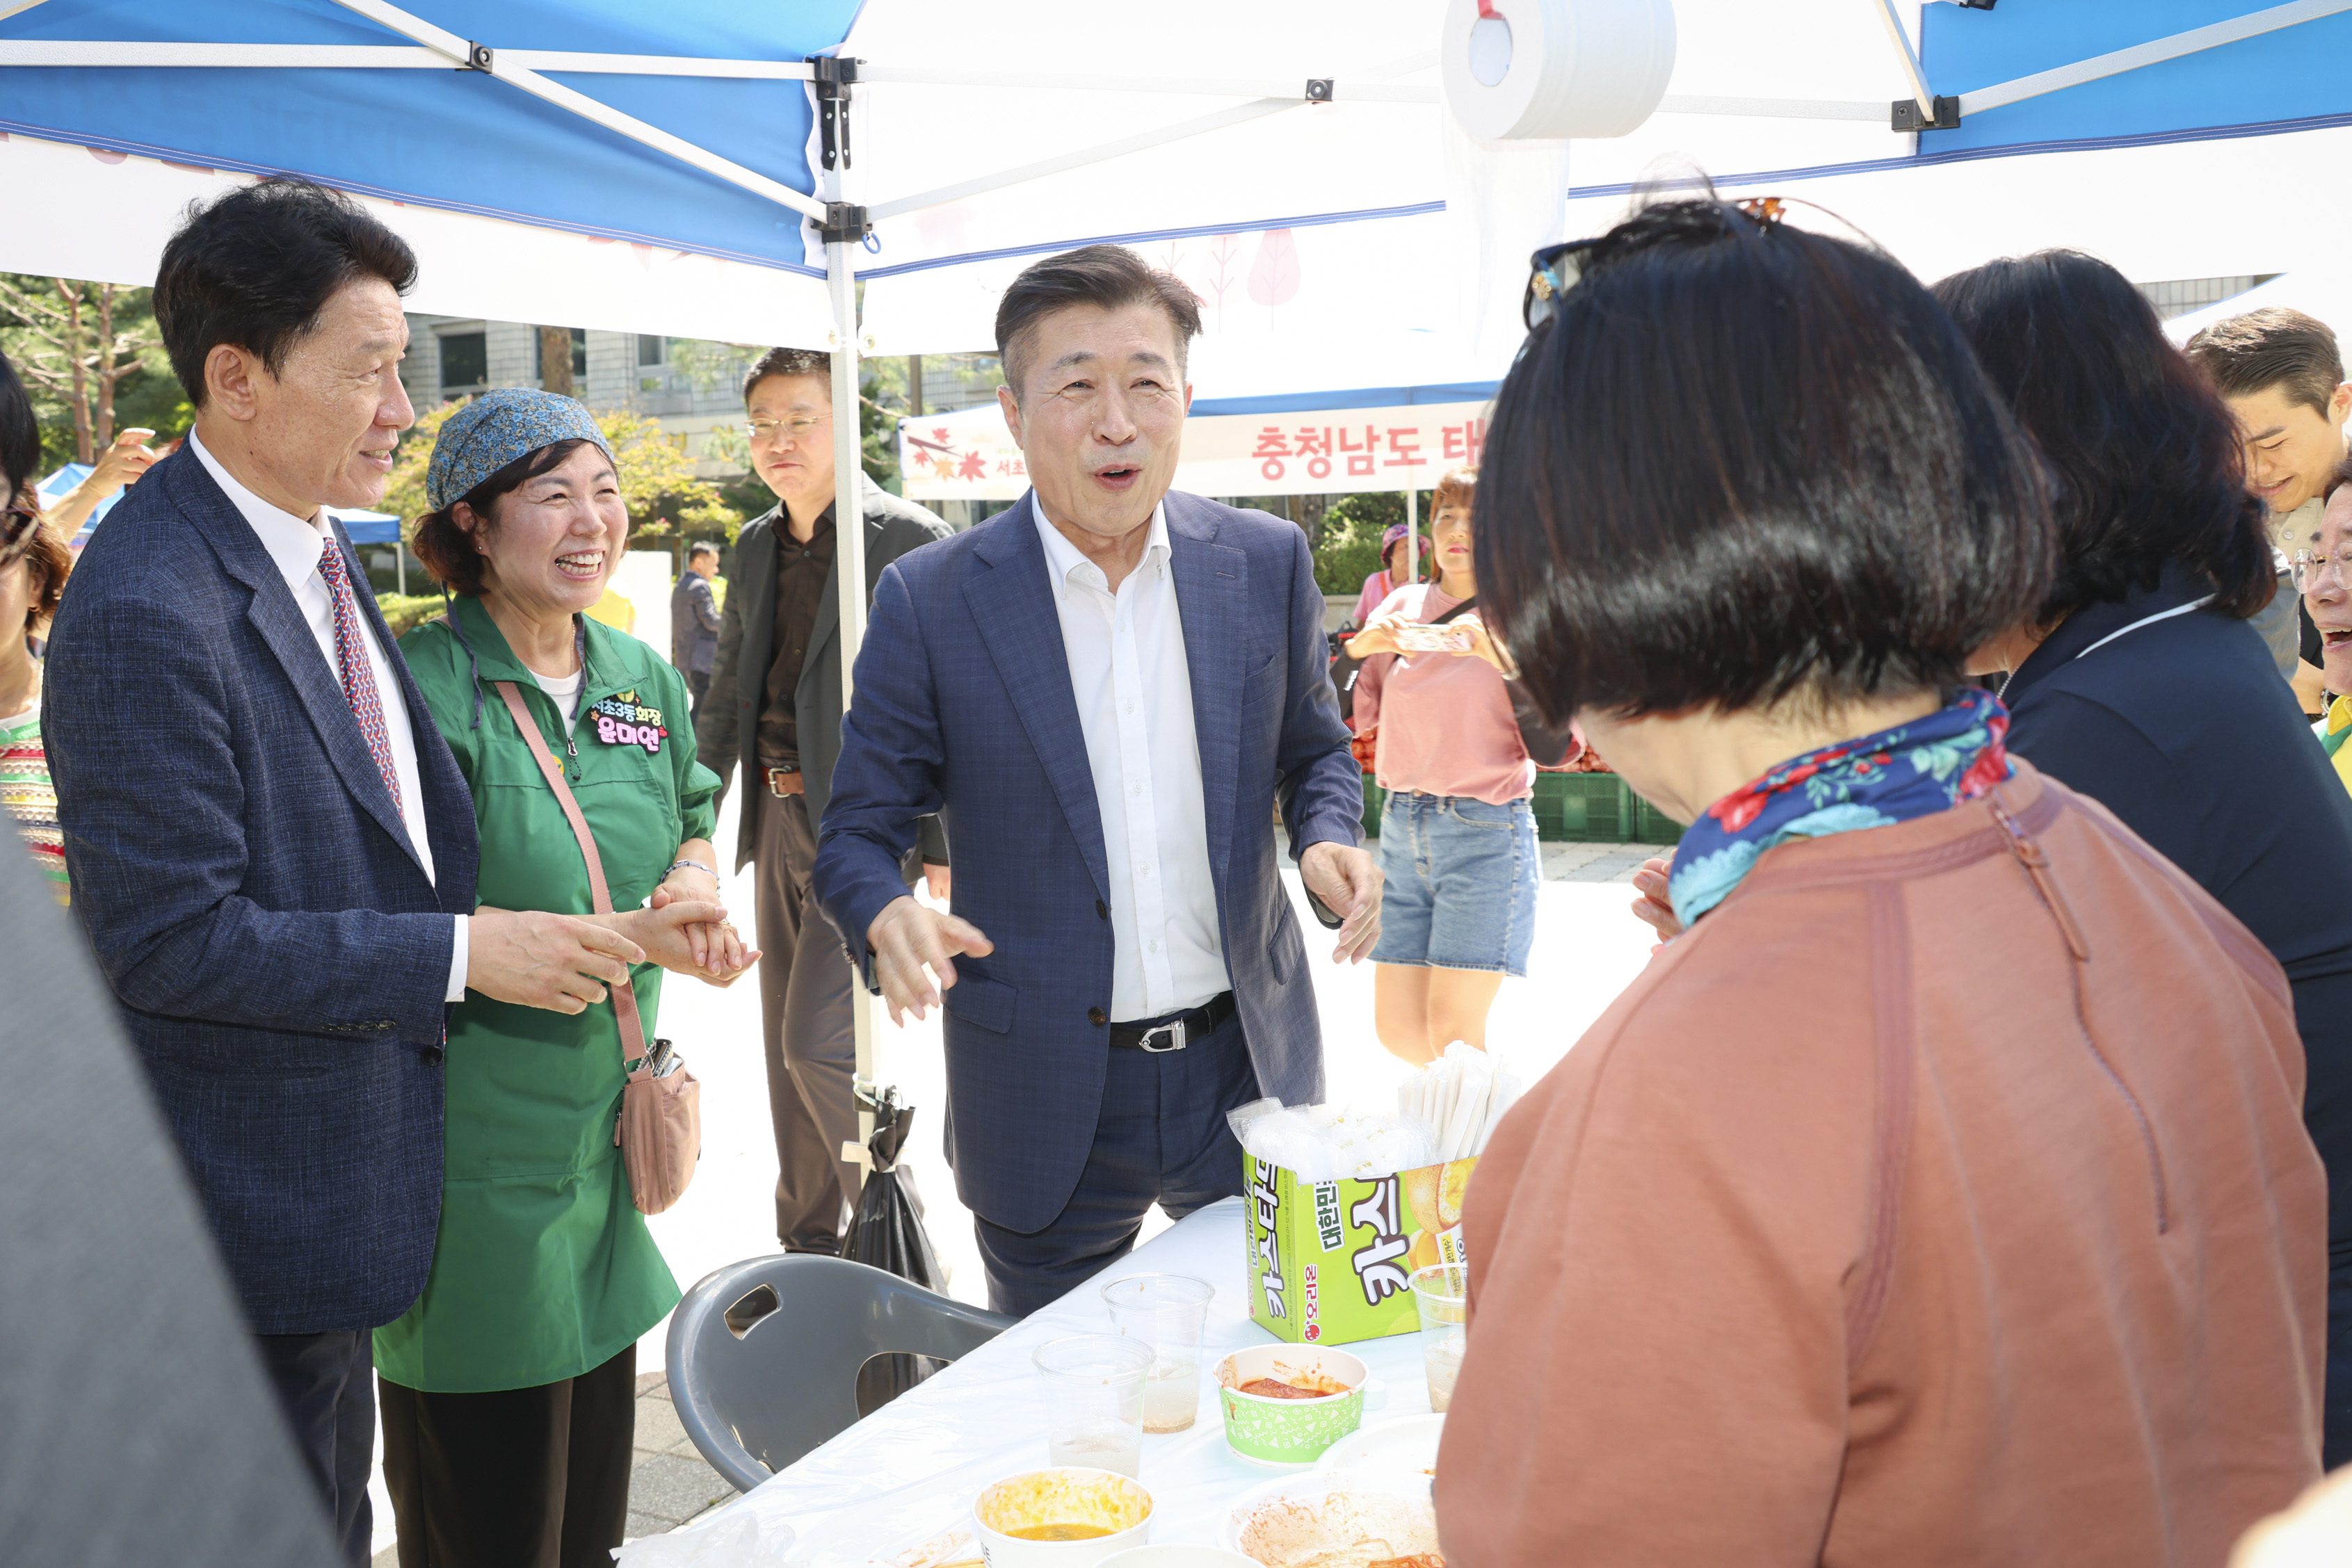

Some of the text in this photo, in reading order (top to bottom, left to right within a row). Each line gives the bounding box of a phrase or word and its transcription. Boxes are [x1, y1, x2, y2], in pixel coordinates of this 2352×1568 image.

[996, 459, 1026, 476] 서초
[1252, 424, 1427, 481] 충청남도
[591, 698, 662, 727] 서초3동 회장
[598, 716, 660, 752] 윤미연
[1315, 1180, 1343, 1250] 대한민
[1351, 1172, 1410, 1307] 카스
[1305, 1264, 1319, 1320] 오리온
